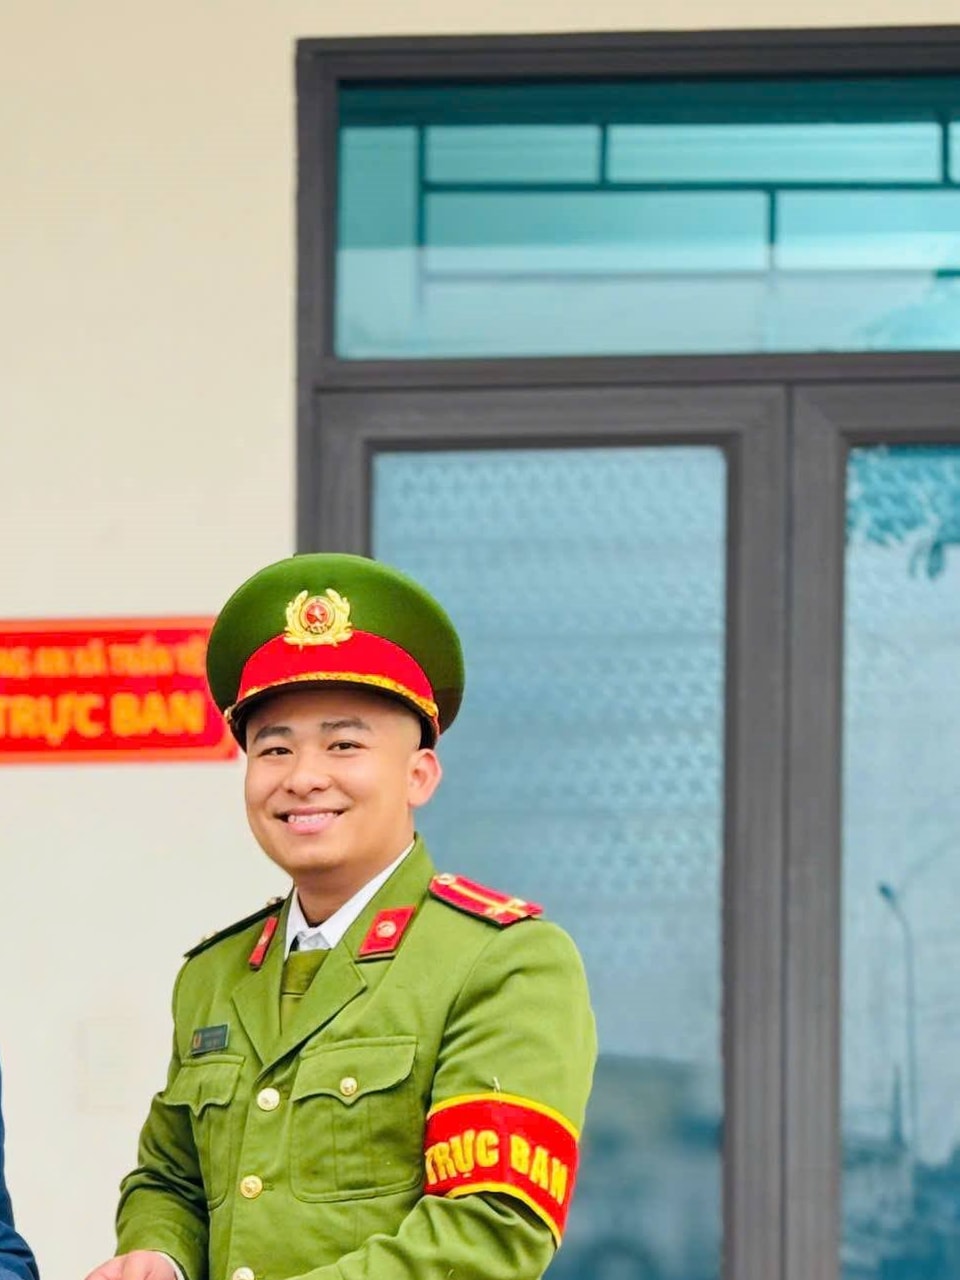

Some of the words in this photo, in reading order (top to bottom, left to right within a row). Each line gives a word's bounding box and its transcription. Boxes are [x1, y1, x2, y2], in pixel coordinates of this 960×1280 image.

[109, 690, 205, 736] BAN
[425, 1129, 499, 1185] TRỰC
[510, 1134, 568, 1205] BAN
